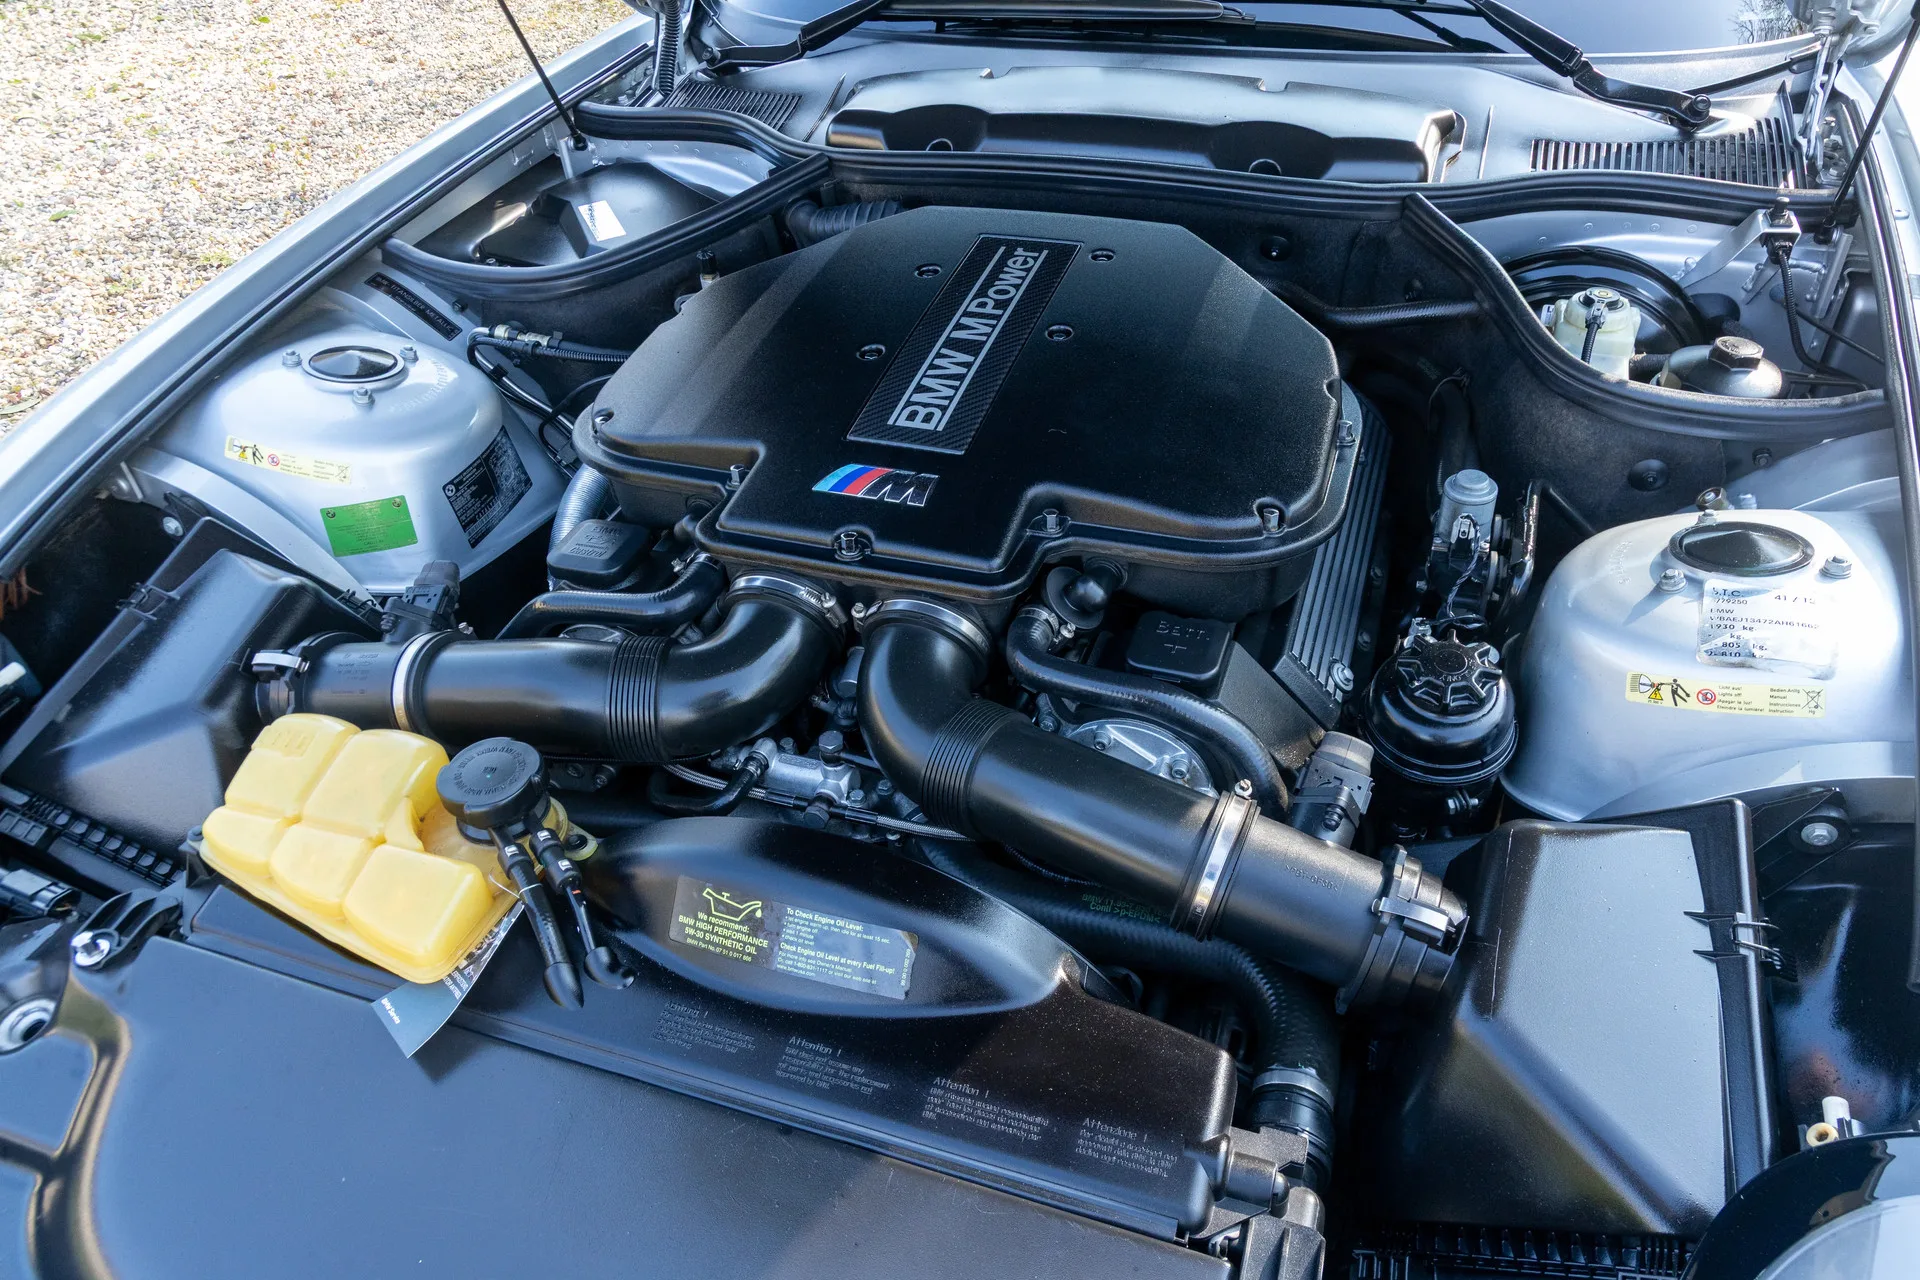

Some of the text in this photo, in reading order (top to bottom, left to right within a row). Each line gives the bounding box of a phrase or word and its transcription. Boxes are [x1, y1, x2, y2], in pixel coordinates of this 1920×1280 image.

[895, 246, 1041, 431] BMW MPower
[1722, 641, 1742, 649] 805
[678, 914, 770, 949] BMW HIGH PERFORMANCE
[698, 911, 751, 934] We recommend:
[786, 908, 864, 932] To Check Engine Oil Level:
[684, 926, 758, 955] 5W-30 SYNTHETIC OIL
[686, 937, 699, 946] BMW
[780, 942, 798, 952] Check
[797, 946, 816, 957] Engine
[816, 951, 825, 959] Oil
[825, 953, 840, 962] Level
[846, 959, 862, 969] every
[862, 961, 876, 971] Fuel
[788, 1035, 833, 1055] Attention
[932, 1076, 981, 1096] Attention
